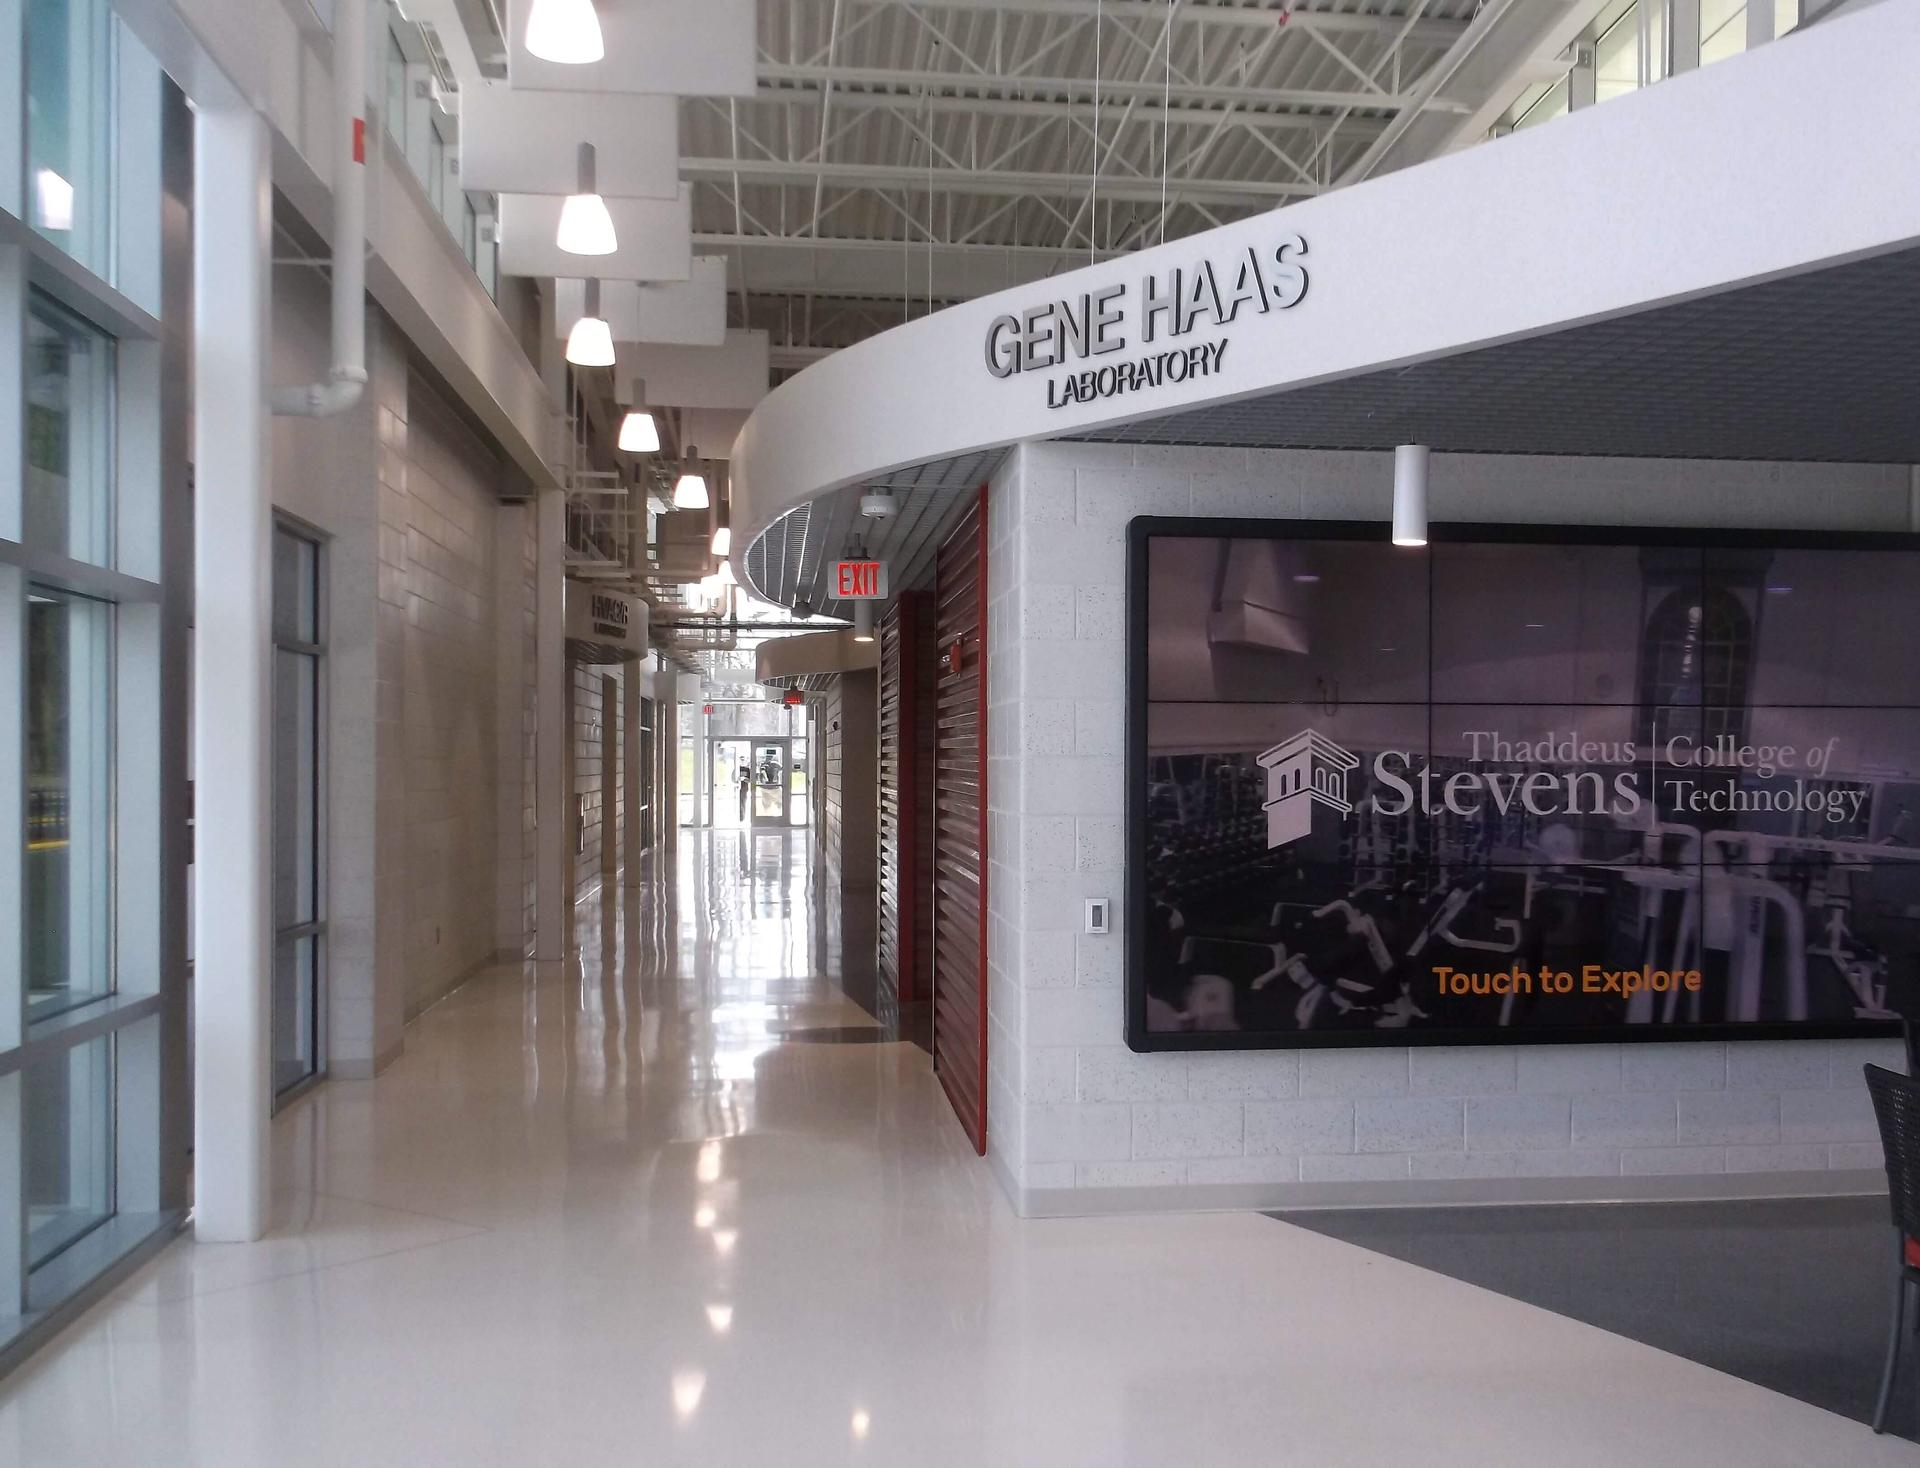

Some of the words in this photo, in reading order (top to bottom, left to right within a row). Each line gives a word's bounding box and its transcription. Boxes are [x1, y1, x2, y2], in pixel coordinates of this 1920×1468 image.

[984, 283, 1125, 378] GENE
[1141, 233, 1309, 342] HAAS
[1047, 338, 1229, 409] LABORATORY
[837, 562, 880, 597] EXIT
[1462, 730, 1637, 764] Thaddeus
[1665, 734, 1797, 779] College
[1806, 737, 1840, 779] of
[1371, 750, 1641, 816] Stevens
[1663, 778, 1866, 823] Technology
[1432, 966, 1532, 995] Touch
[1539, 965, 1574, 993] to
[1582, 964, 1702, 999] Explore
